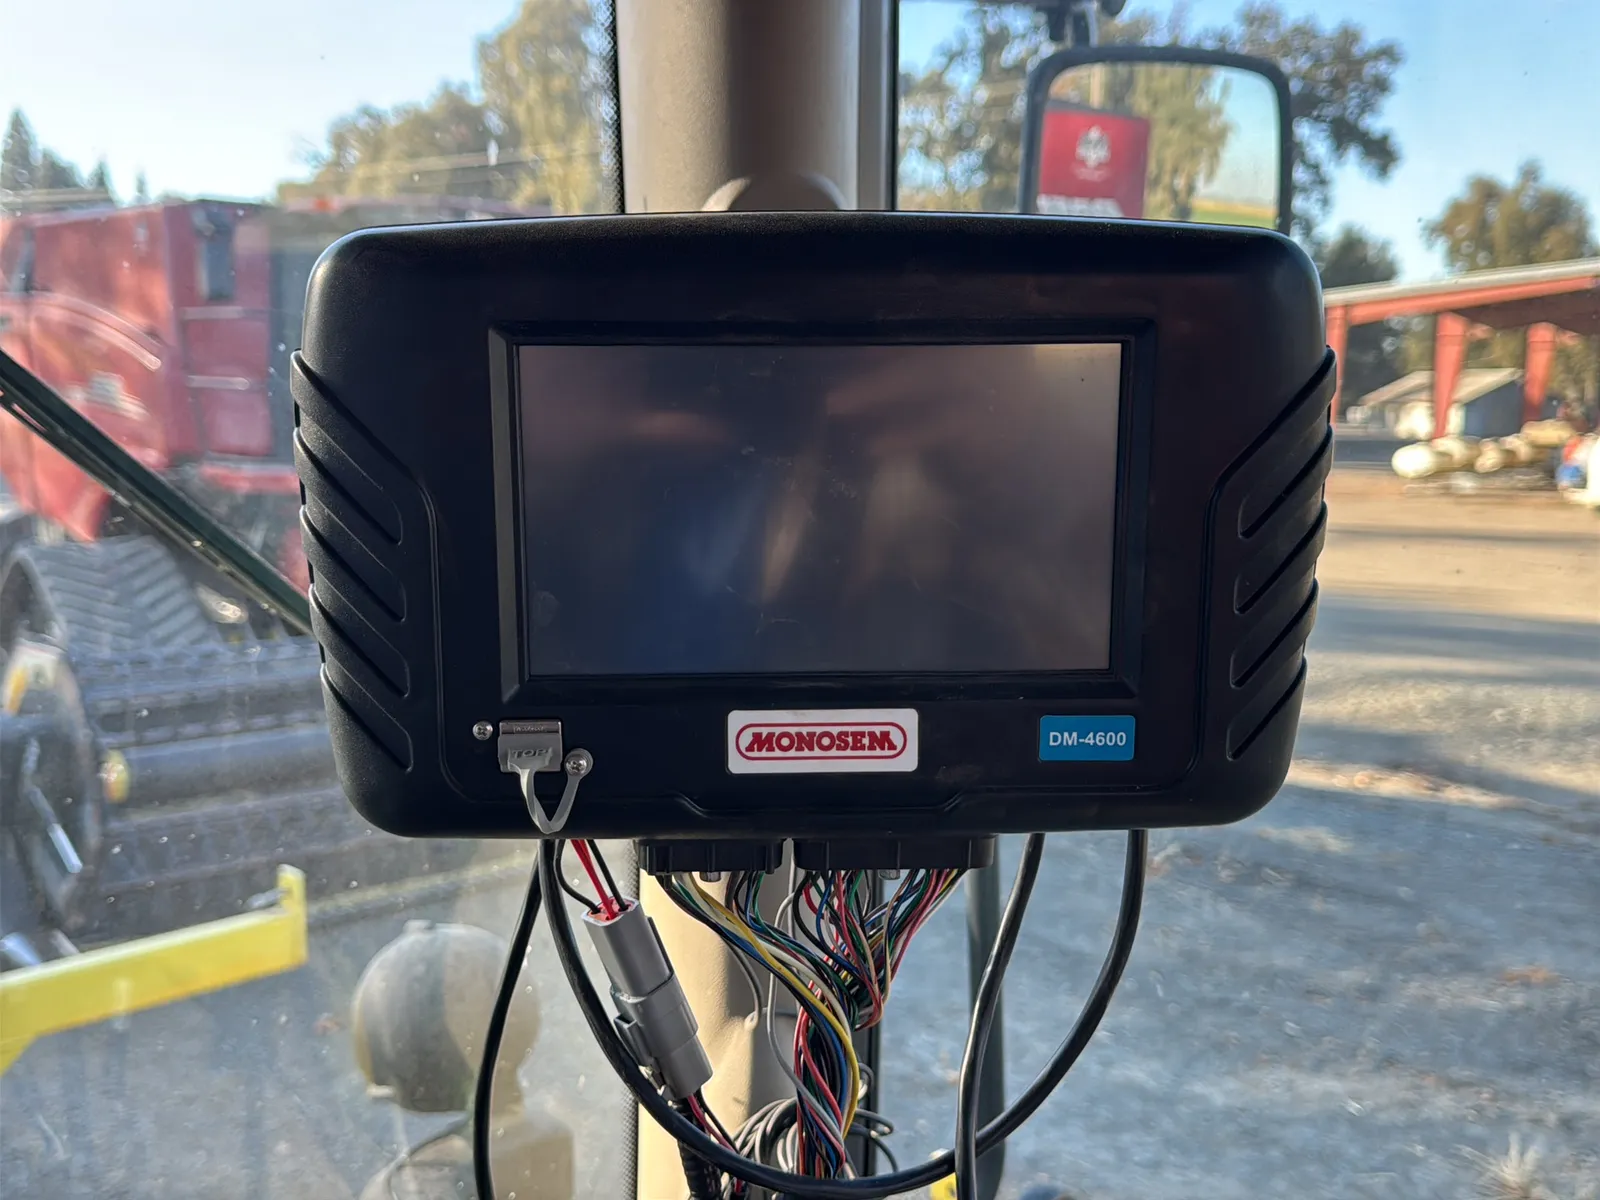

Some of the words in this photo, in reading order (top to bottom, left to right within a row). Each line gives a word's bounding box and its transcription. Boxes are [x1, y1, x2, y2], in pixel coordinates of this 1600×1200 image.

[745, 730, 897, 752] MONOSEM
[1049, 731, 1127, 746] DM-4600
[511, 748, 549, 759] TOP
